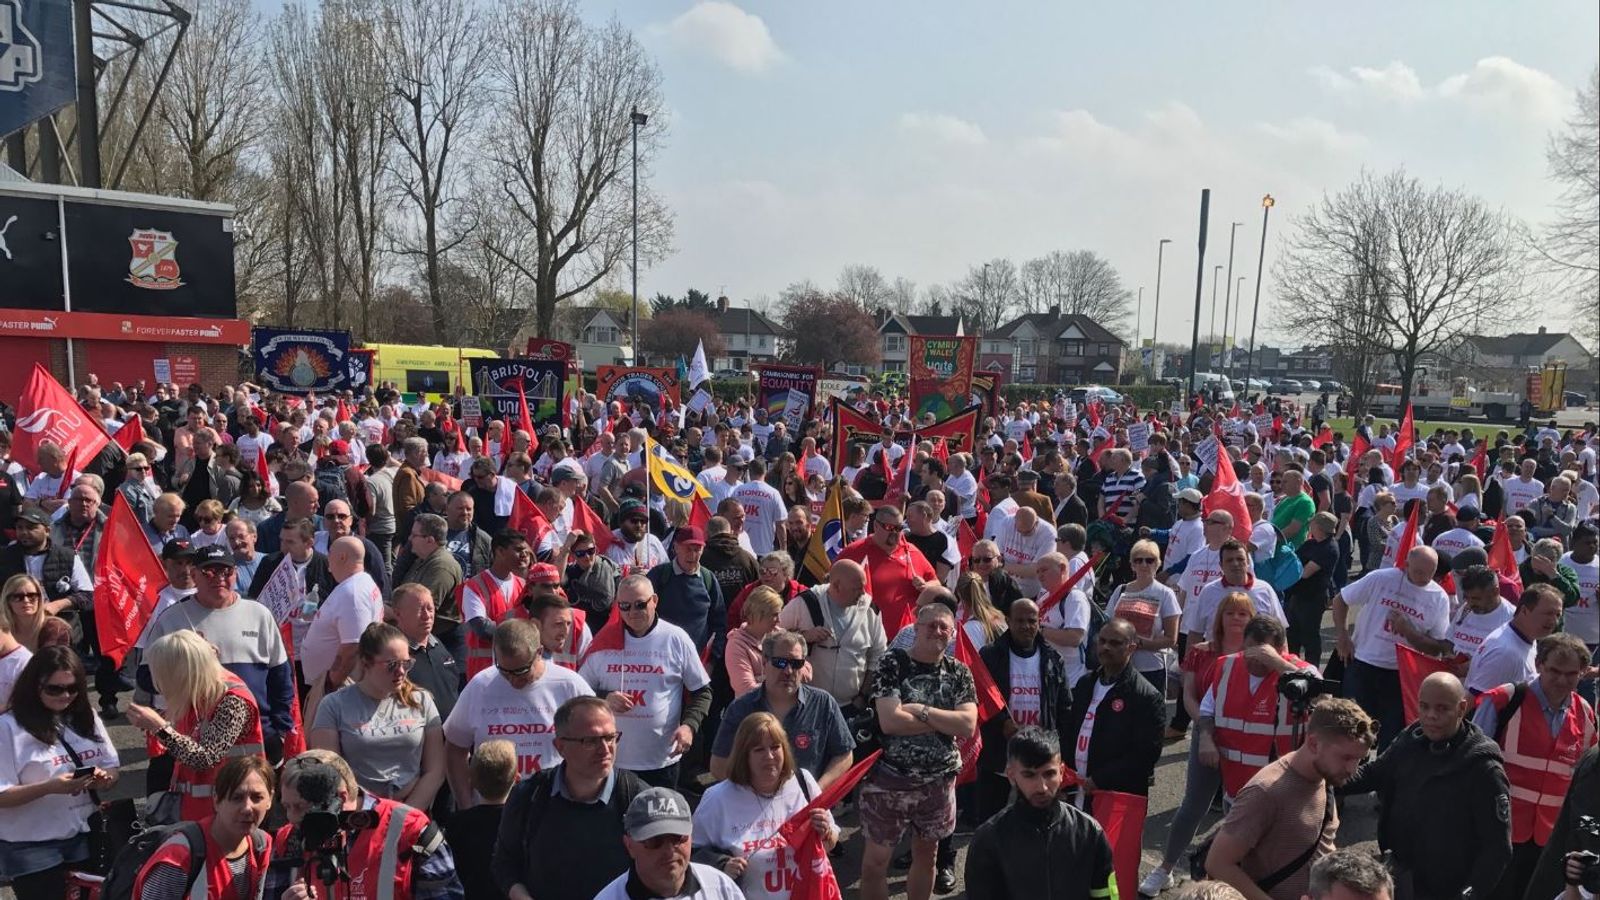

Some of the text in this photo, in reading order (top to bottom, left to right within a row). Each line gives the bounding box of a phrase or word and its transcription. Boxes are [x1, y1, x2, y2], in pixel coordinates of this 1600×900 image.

[0, 321, 53, 330] ASTER PUMA
[927, 340, 958, 349] CYMRU
[929, 349, 954, 357] WALES
[927, 361, 953, 371] unite
[490, 364, 541, 383] BRISTOL
[761, 377, 814, 391] EQUALITY
[498, 399, 535, 415] unie
[744, 504, 760, 517] UK
[1436, 539, 1467, 549] HOND
[1381, 598, 1424, 621] HONDA
[1455, 631, 1483, 645] HOND
[607, 664, 665, 674] HONDA
[1010, 686, 1041, 696] OND
[1013, 710, 1040, 726] UK
[487, 723, 557, 736] HONDA
[743, 838, 788, 853] HON
